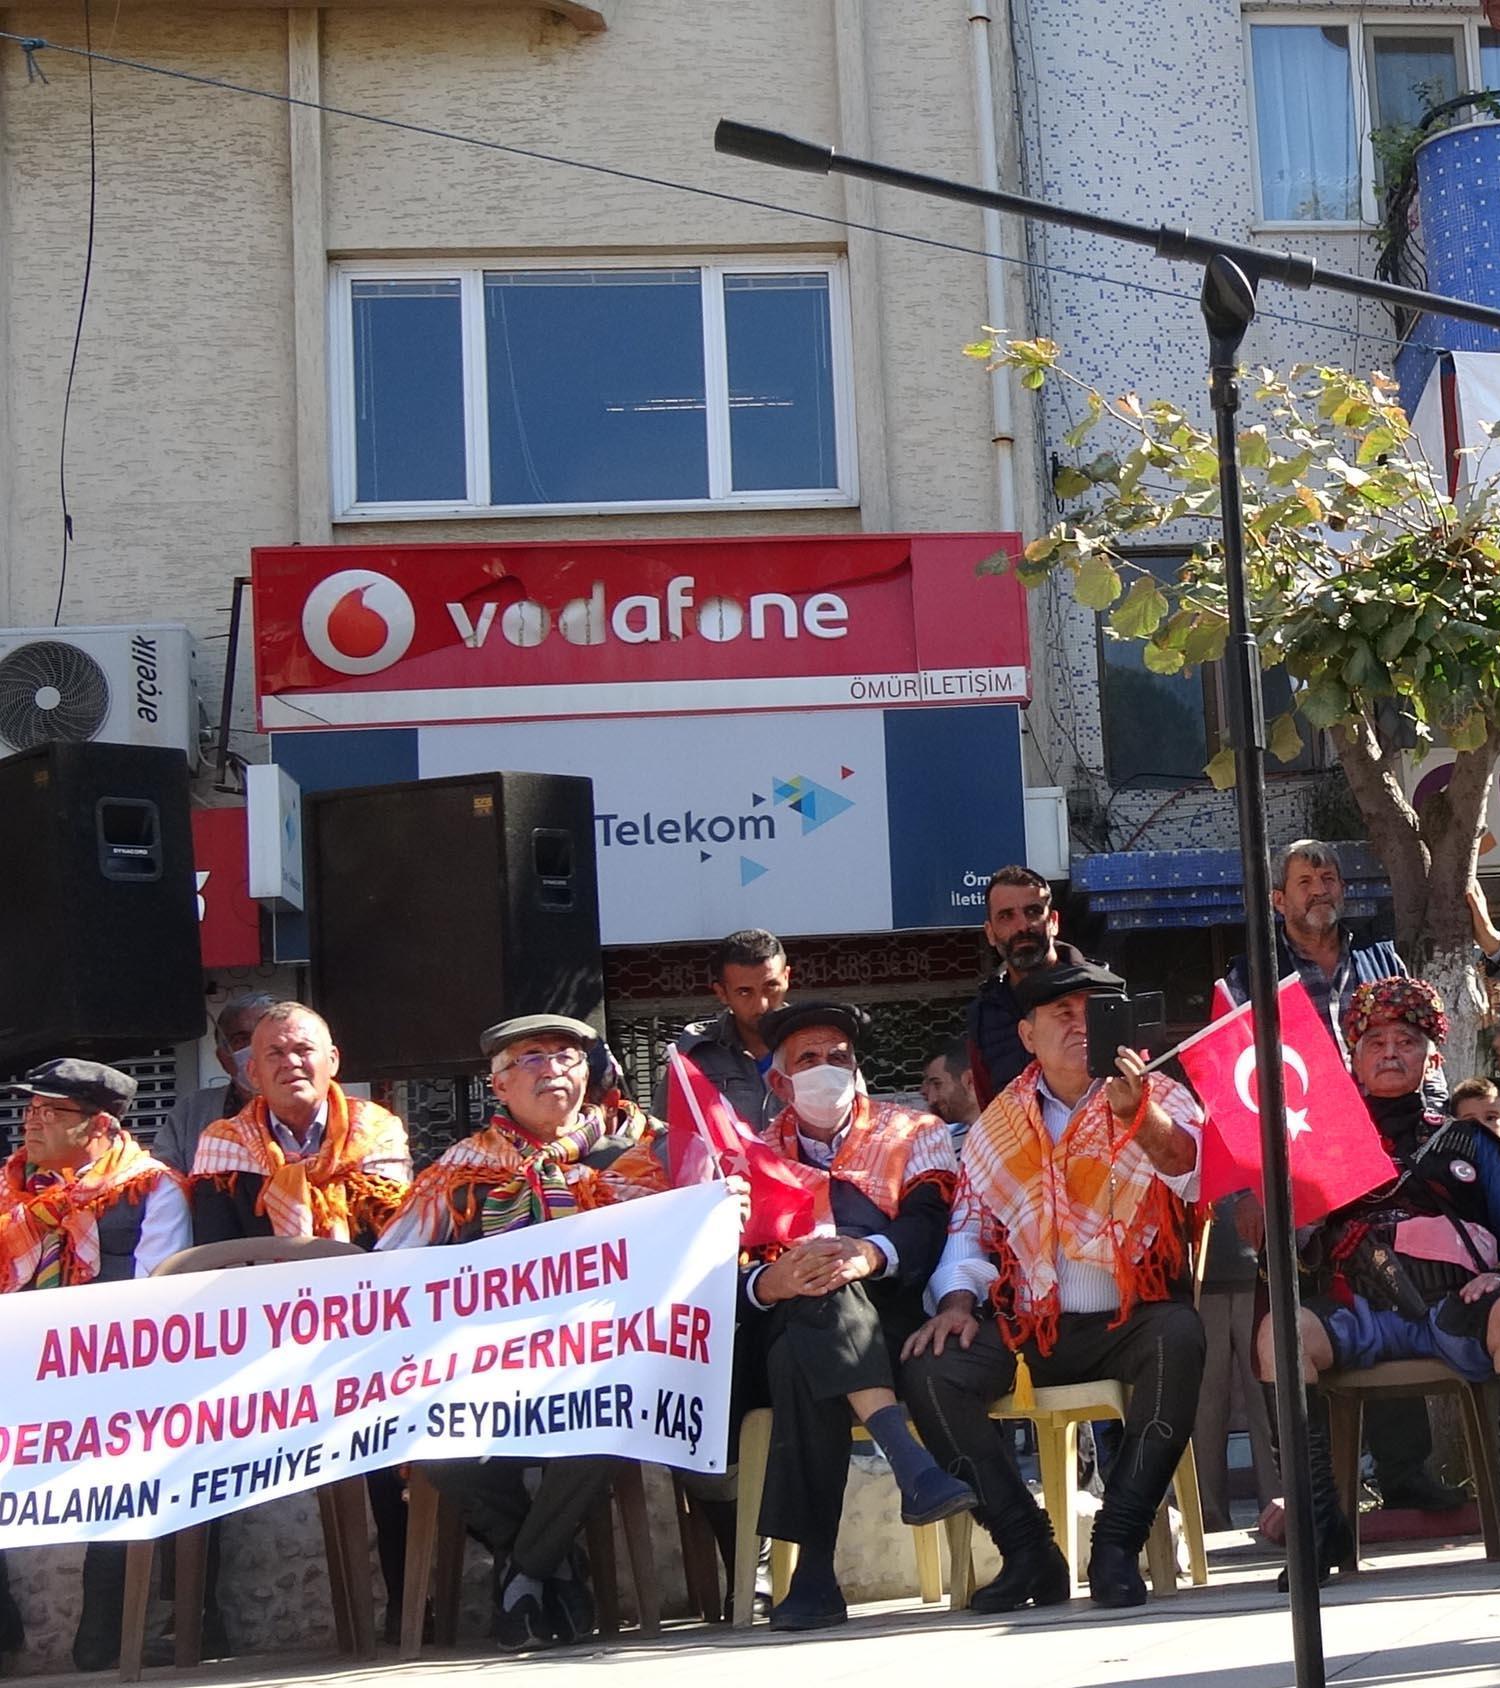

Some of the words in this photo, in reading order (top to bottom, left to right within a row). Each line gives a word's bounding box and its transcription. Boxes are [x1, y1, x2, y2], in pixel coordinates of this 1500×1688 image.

[447, 575, 849, 648] vodafone
[135, 633, 162, 725] arçelik
[850, 673, 918, 699] ÖMÜR
[924, 669, 1013, 697] İLETİŞİM
[594, 810, 776, 847] Telekom
[36, 1307, 248, 1382] ANADOLU
[262, 1280, 411, 1350] YÖRÜK
[424, 1238, 630, 1317] TÜRKMEN
[334, 1353, 457, 1417] BAĞLI
[470, 1303, 713, 1374] DERNEKLER
[0, 1479, 161, 1526] DALAMAN
[190, 1443, 323, 1509] FETHİYE
[350, 1416, 400, 1462] NİF
[427, 1383, 634, 1438] SEYDİKEMER
[655, 1389, 703, 1456] KAŞ
